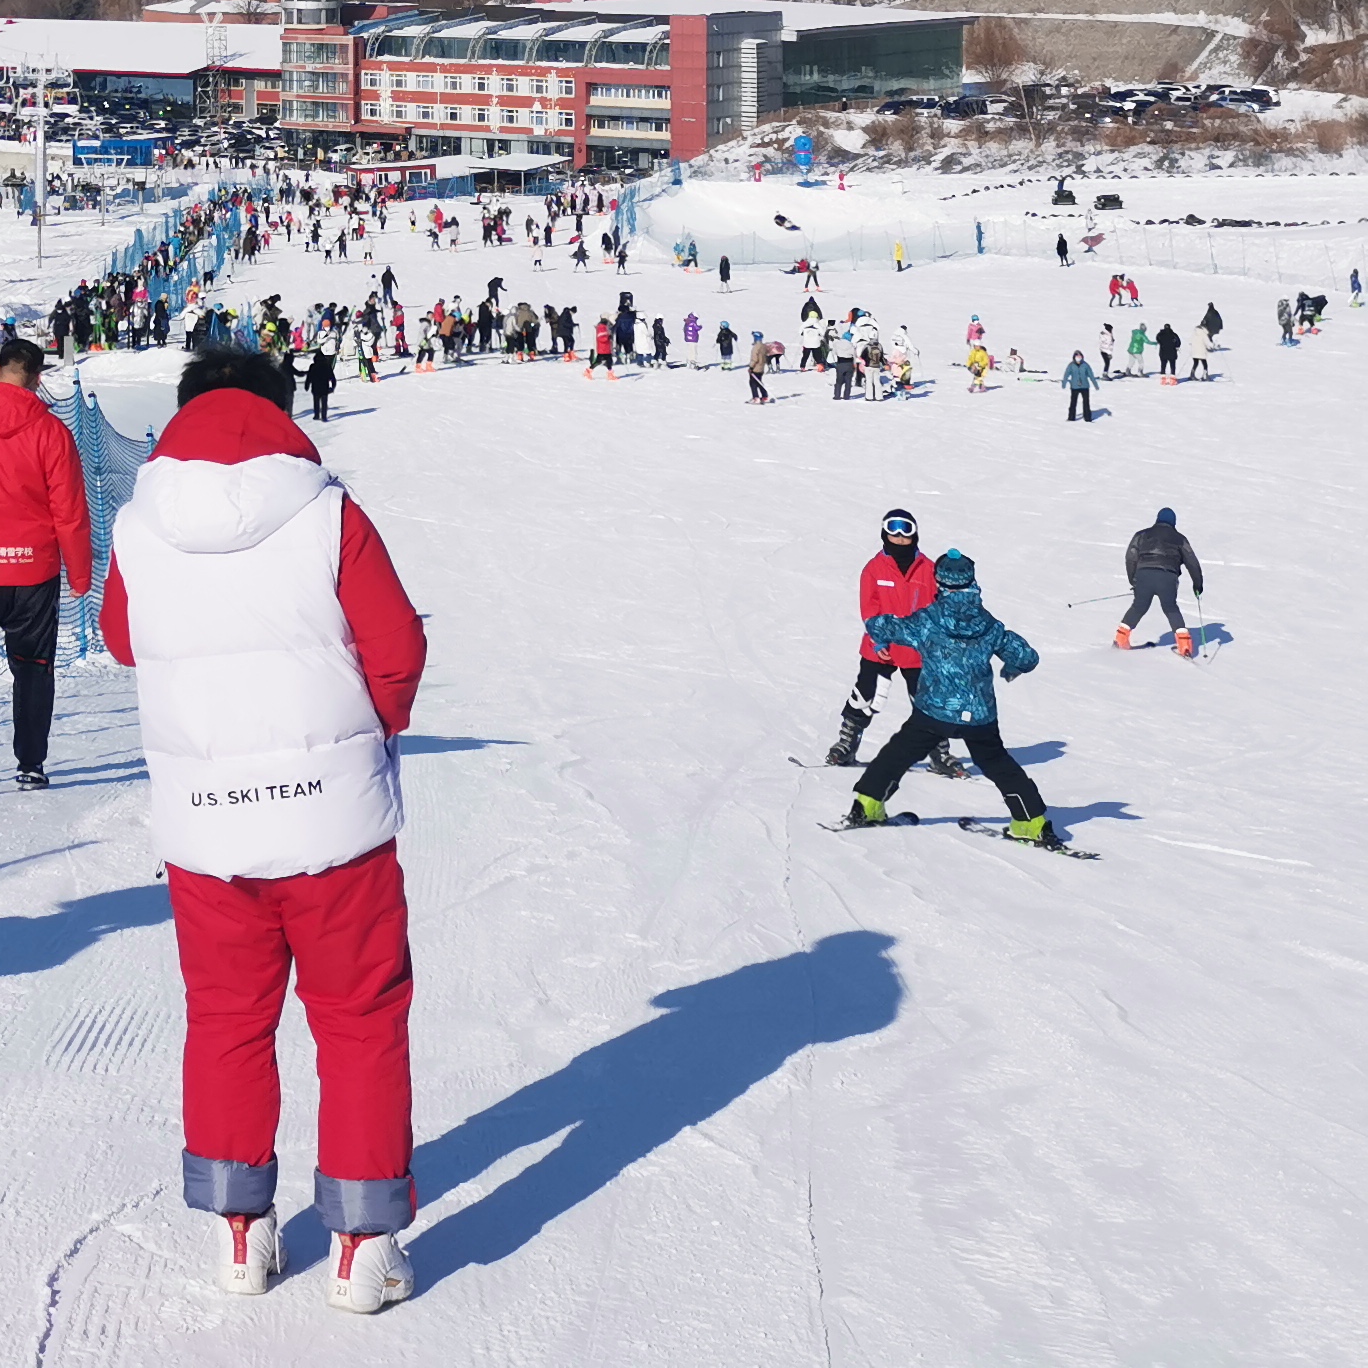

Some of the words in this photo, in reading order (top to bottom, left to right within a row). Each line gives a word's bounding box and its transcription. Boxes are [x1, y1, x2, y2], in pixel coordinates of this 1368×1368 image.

[191, 792, 222, 806] U.S.
[227, 788, 259, 804] SKI
[265, 779, 323, 800] TEAM
[234, 1269, 245, 1280] 23
[336, 1285, 347, 1297] 23
